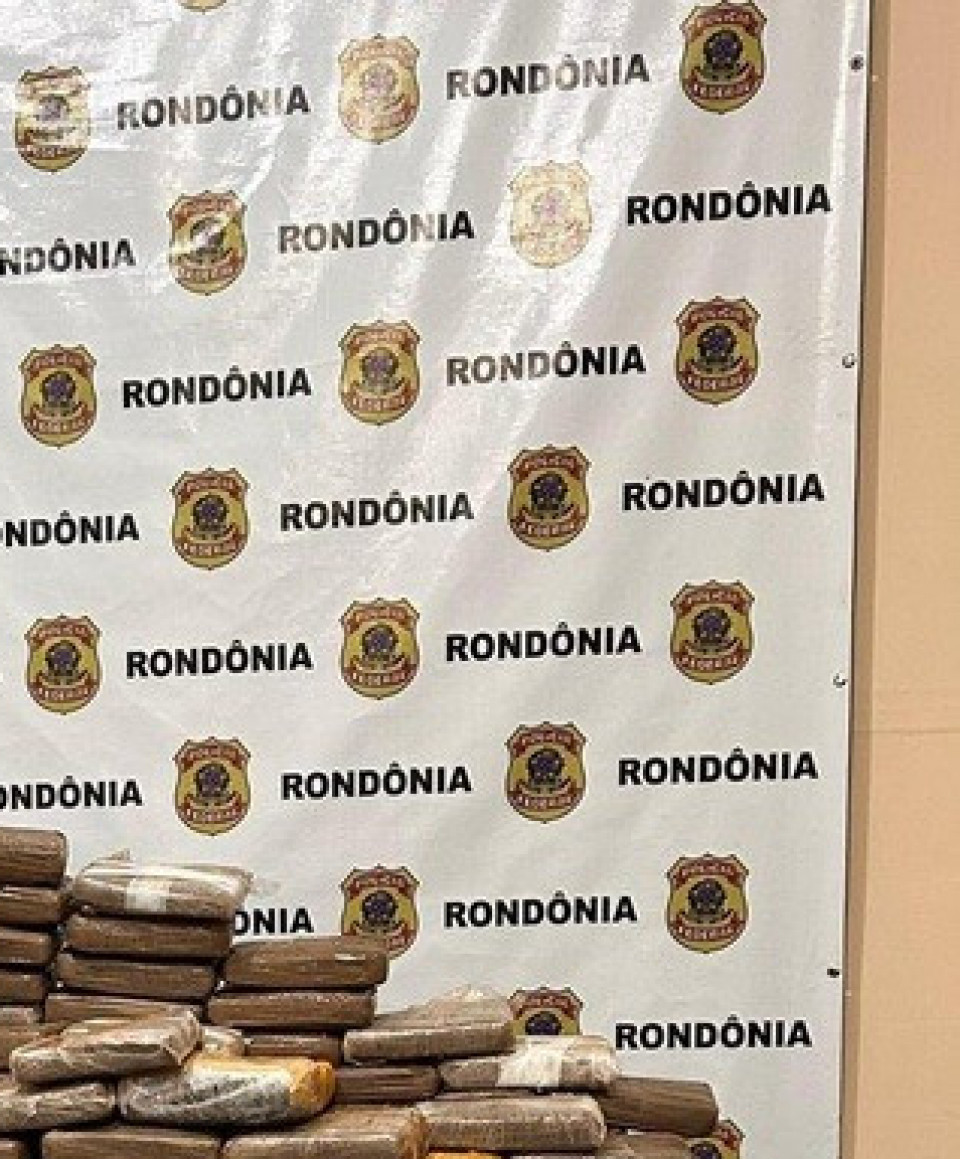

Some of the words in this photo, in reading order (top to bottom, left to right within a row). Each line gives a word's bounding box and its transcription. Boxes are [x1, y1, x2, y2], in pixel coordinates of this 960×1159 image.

[447, 54, 650, 100] RONDÔNIA
[118, 85, 311, 130] RONDÔNIA
[627, 181, 832, 226] RONDÔNIA
[279, 208, 475, 254] RONDÔNIA
[447, 341, 646, 386] RONDÔNIA
[123, 366, 312, 408] RONDÔNIA
[622, 471, 825, 511] RONDÔNIA
[280, 491, 474, 532] RONDÔNIA
[126, 640, 314, 679] RONDÔNIA
[446, 622, 643, 662] RONDÔNIA
[281, 761, 472, 801] RONDÔNIA
[618, 748, 819, 787] RONDÔNIA
[443, 891, 638, 929] RONDÔNIA
[615, 1015, 812, 1049] RONDÔNIA
